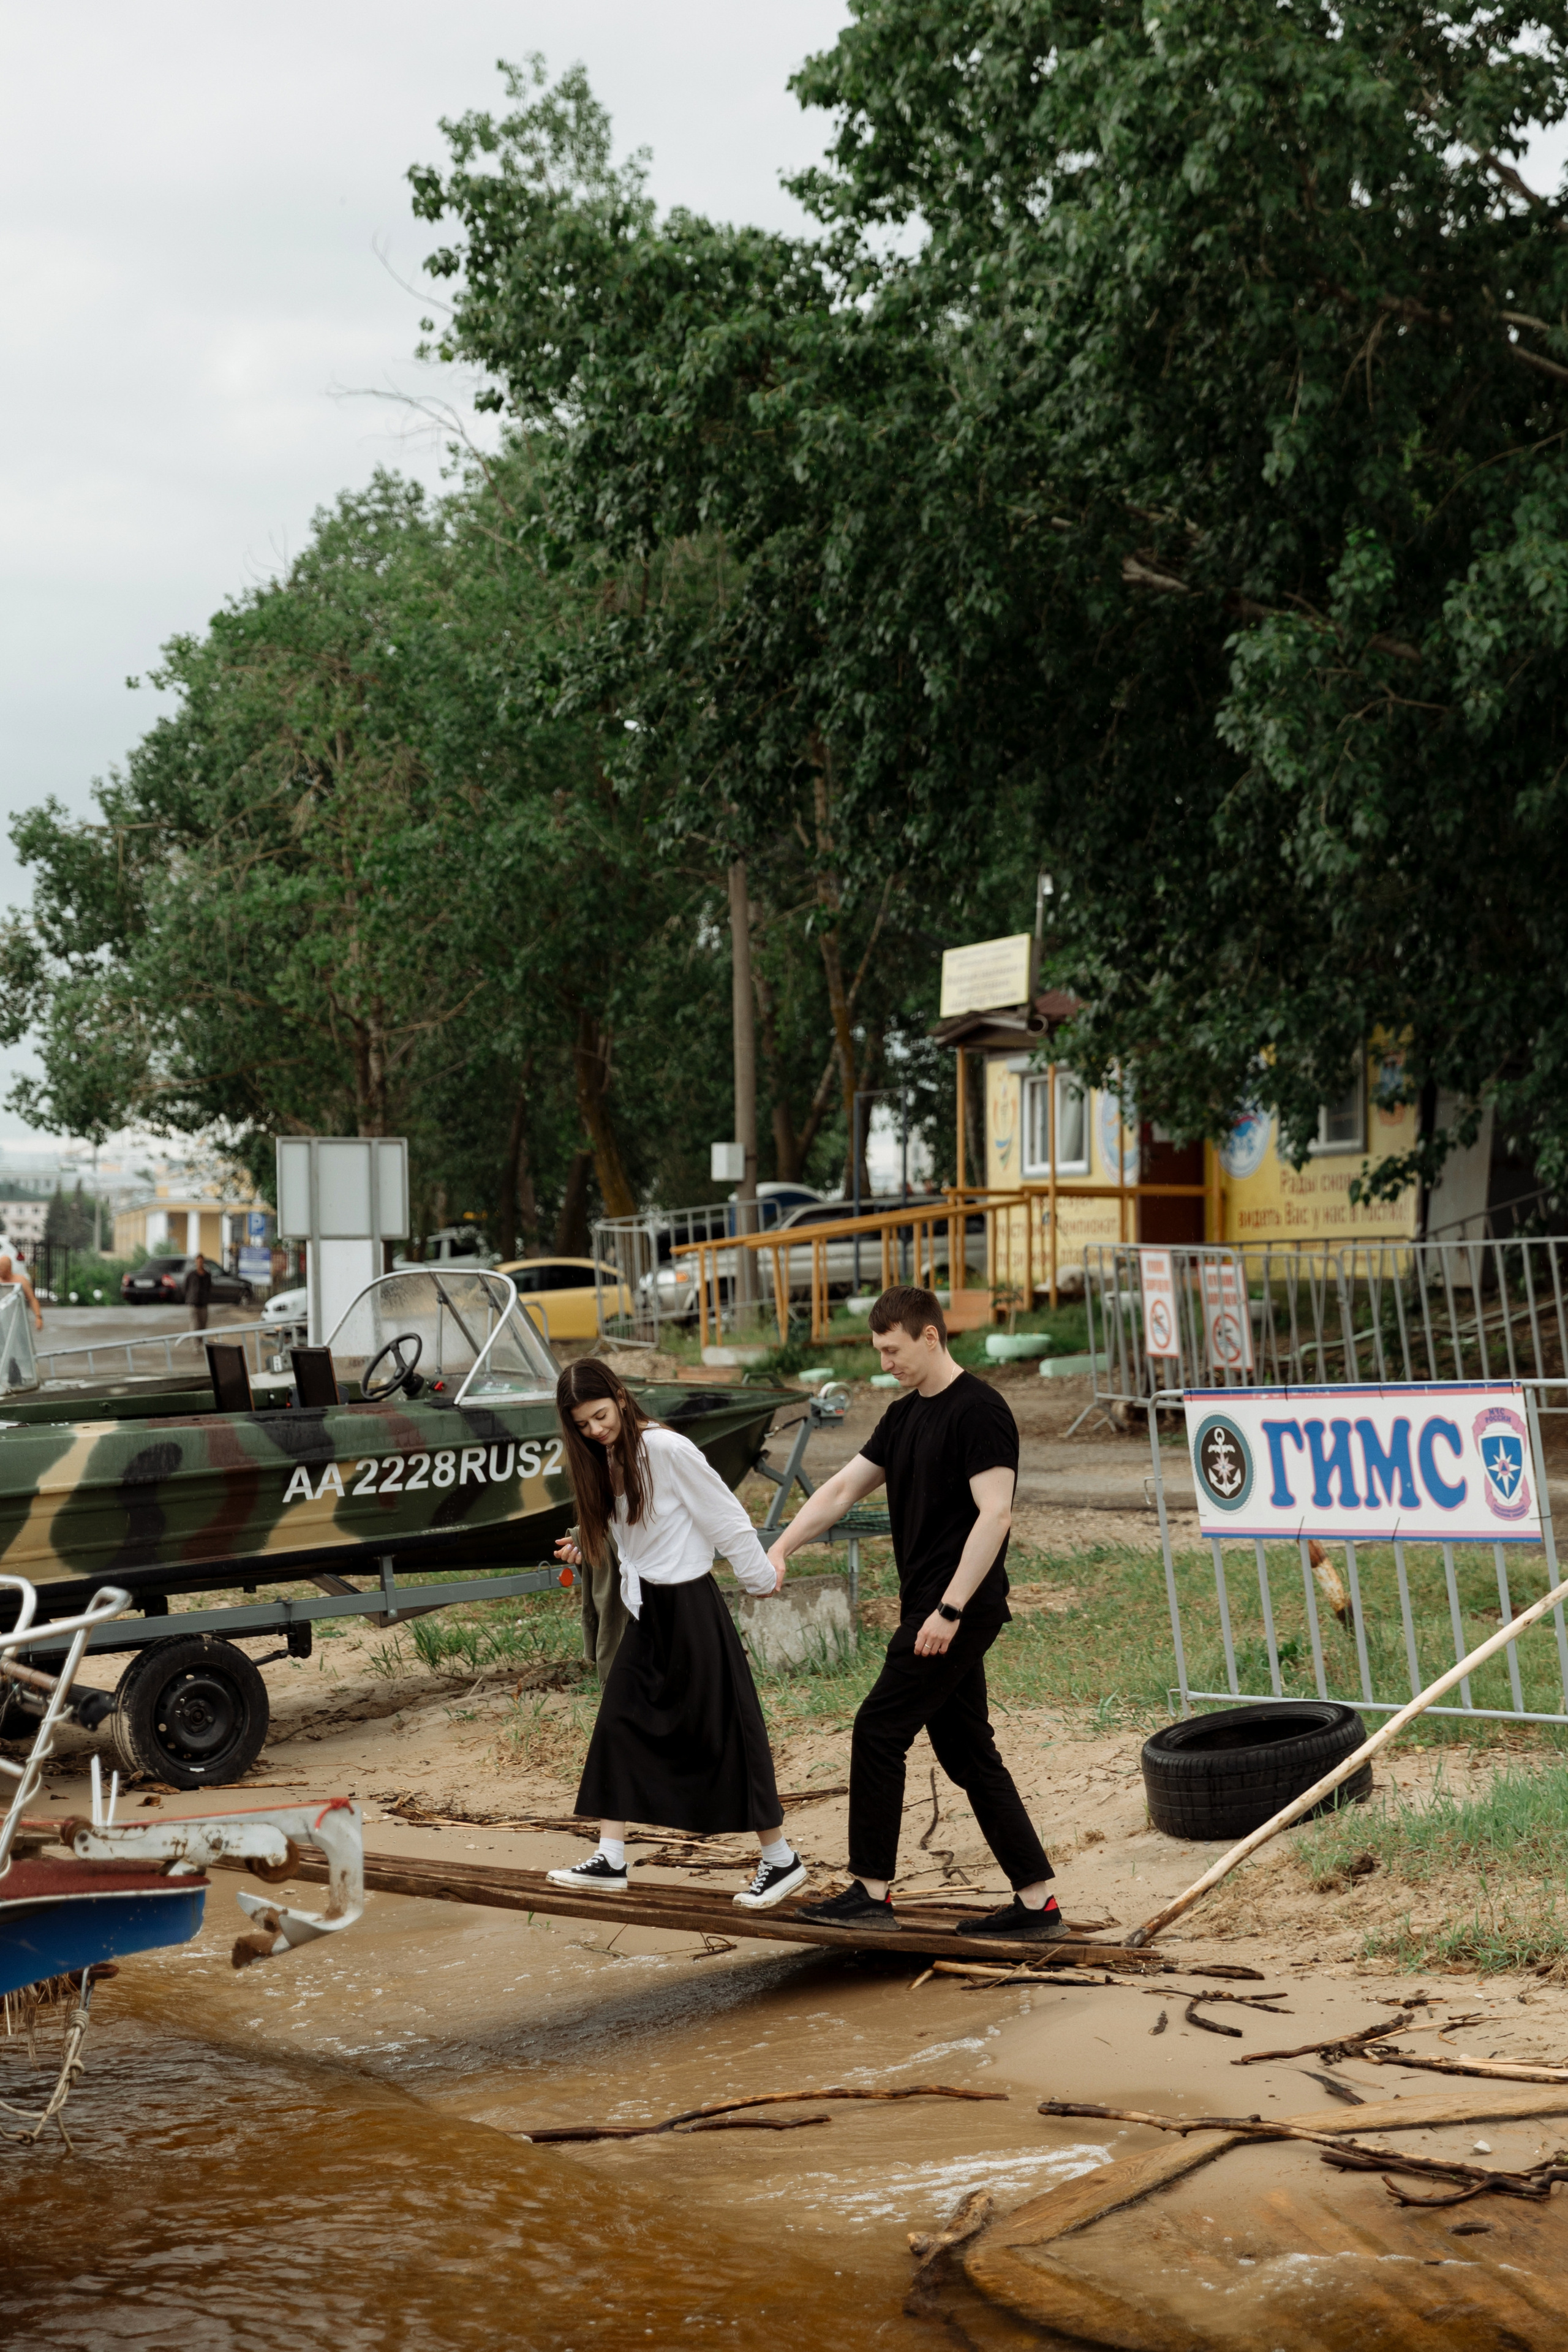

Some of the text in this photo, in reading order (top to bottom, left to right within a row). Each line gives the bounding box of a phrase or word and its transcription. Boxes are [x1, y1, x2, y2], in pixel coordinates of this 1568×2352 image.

[1280, 1169, 1316, 1195] Рады
[1238, 1208, 1281, 1228] видеть
[1284, 1200, 1309, 1226] Вас
[1323, 1204, 1346, 1224] нас
[1485, 1415, 1512, 1423] РОССИИ
[1261, 1415, 1468, 1511] ГИМС
